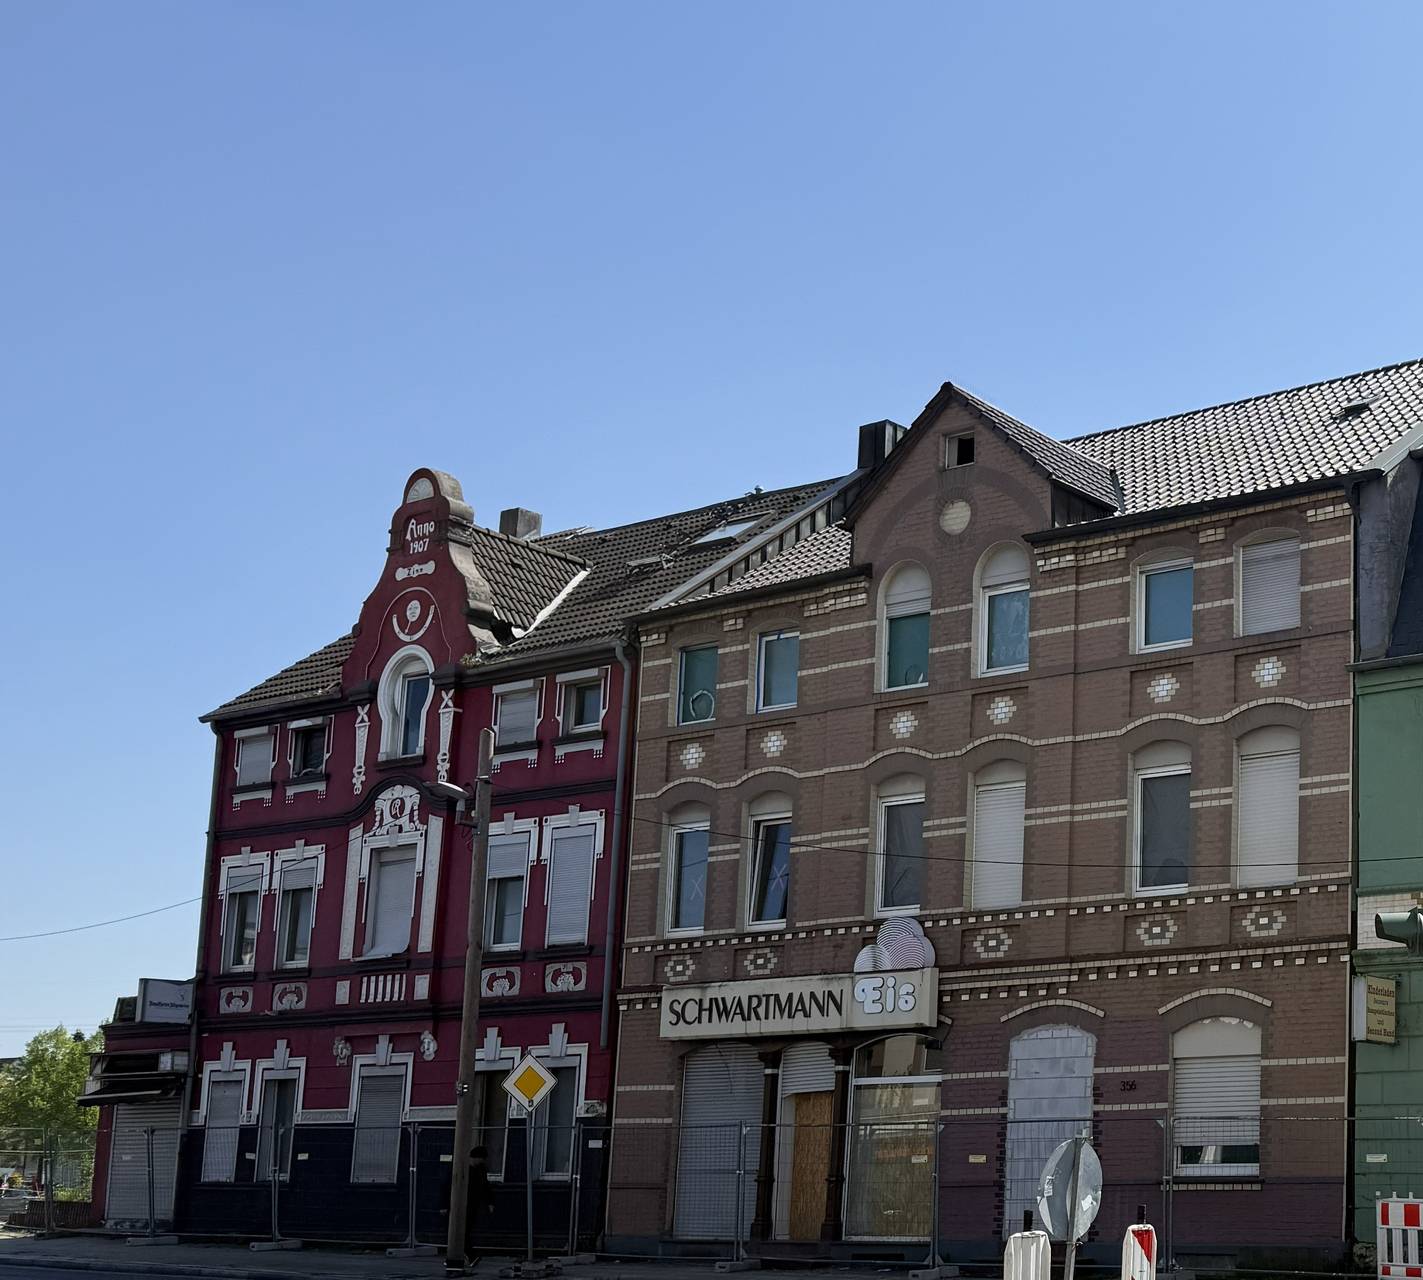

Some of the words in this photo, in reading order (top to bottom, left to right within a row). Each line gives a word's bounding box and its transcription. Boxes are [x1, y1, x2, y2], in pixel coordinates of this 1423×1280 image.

[406, 518, 435, 540] Anno
[410, 538, 430, 554] 1907
[668, 990, 844, 1026] SCHWARTMANN
[853, 976, 917, 1014] Eis
[1120, 1079, 1136, 1091] 356
